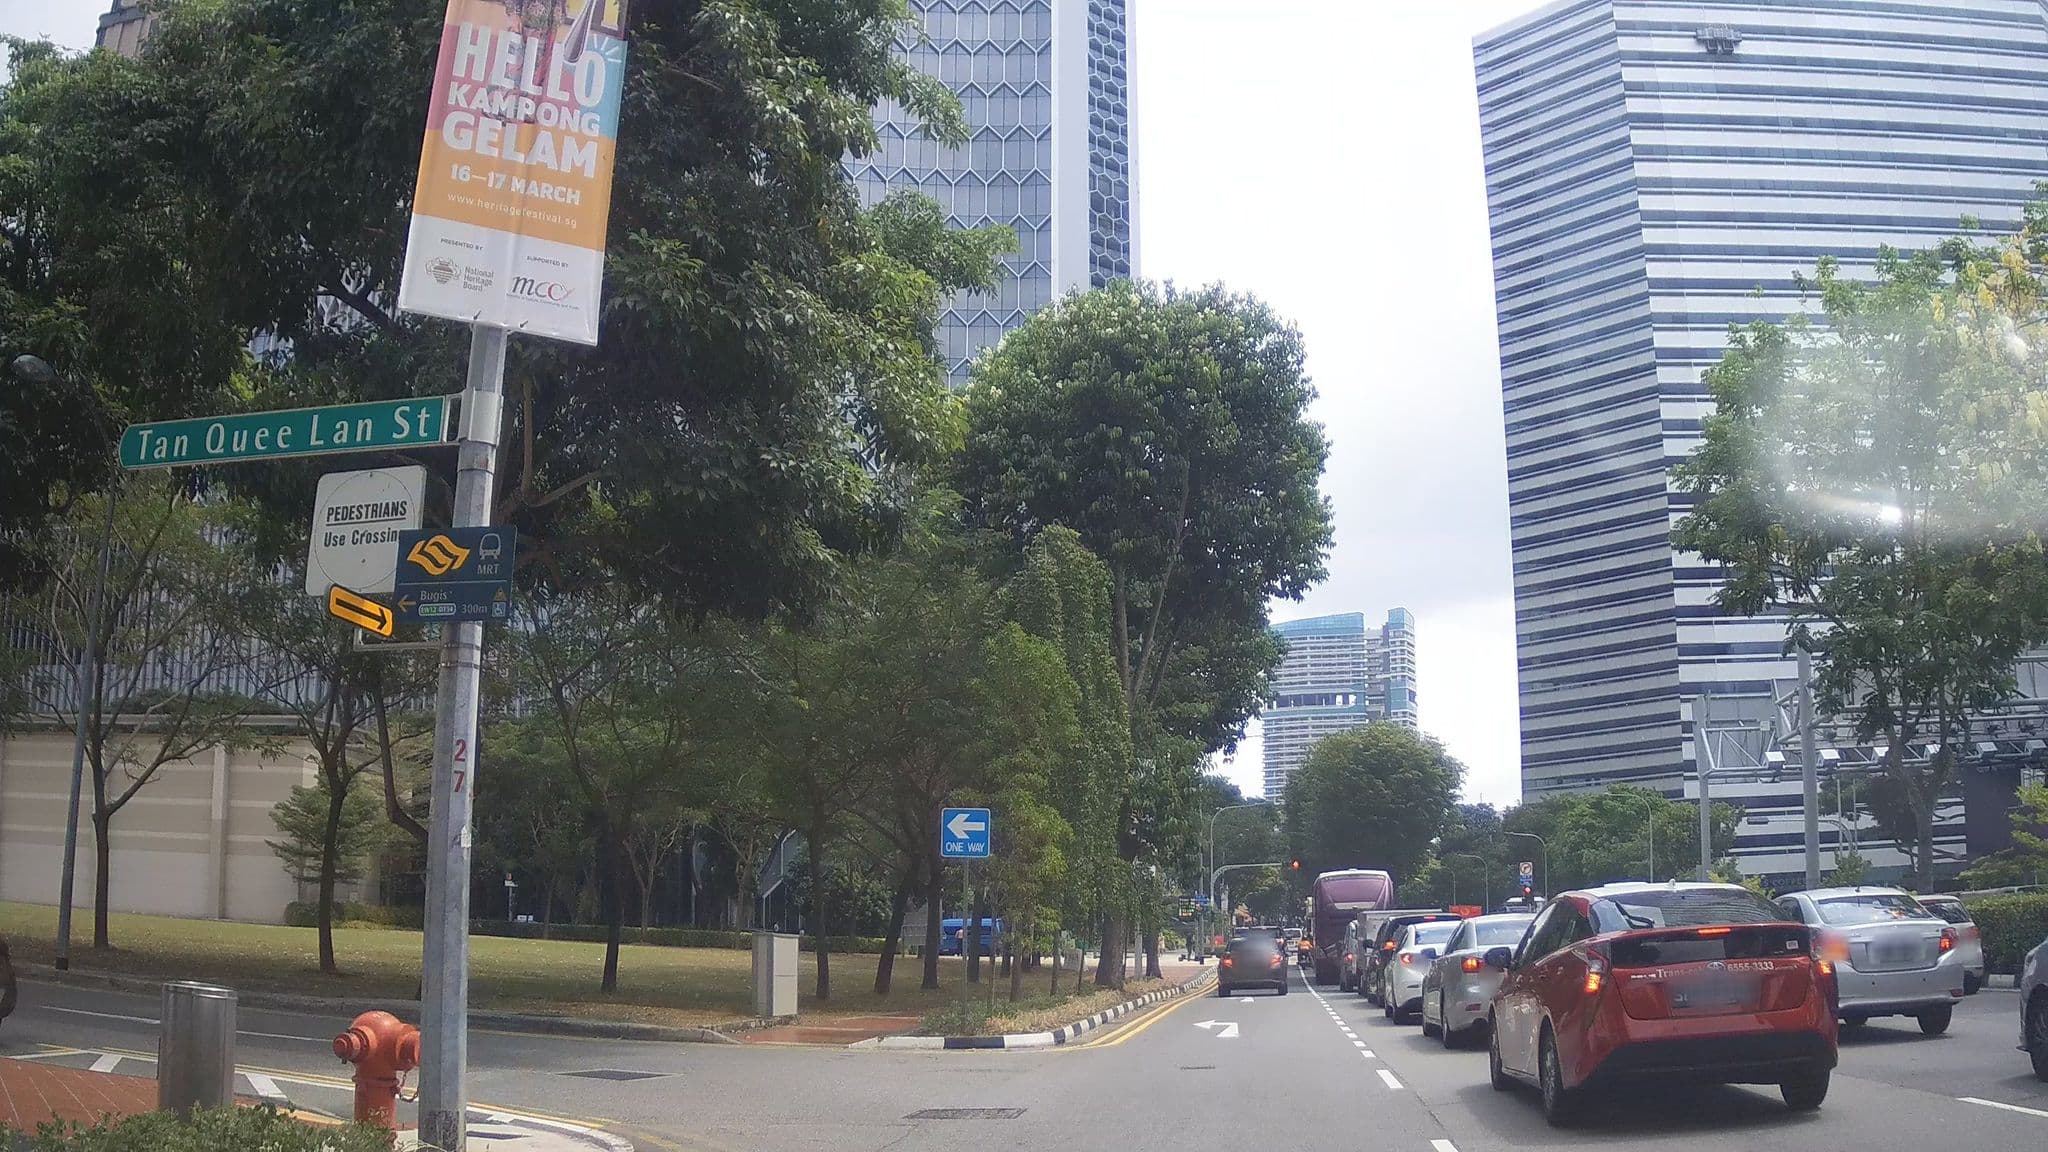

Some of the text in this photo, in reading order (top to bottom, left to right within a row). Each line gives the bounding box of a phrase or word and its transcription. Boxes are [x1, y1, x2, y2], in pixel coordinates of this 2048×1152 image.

[453, 22, 606, 108] HELLO
[448, 82, 600, 137] KAMPONG
[442, 111, 597, 178] GELAM
[511, 175, 581, 206] MARCH
[447, 193, 577, 229] www.heritagefestival.sg
[463, 273, 493, 287] Heritage
[464, 266, 494, 278] National
[462, 281, 483, 292] Board
[139, 405, 430, 460] Tan Quee Lan St
[326, 500, 408, 522] PEDESTRIANS
[324, 527, 398, 548] Use Crossin
[477, 563, 500, 575] MRT
[420, 589, 448, 602] Bugis
[461, 603, 488, 614] 300m
[945, 841, 985, 852] ONE WAY
